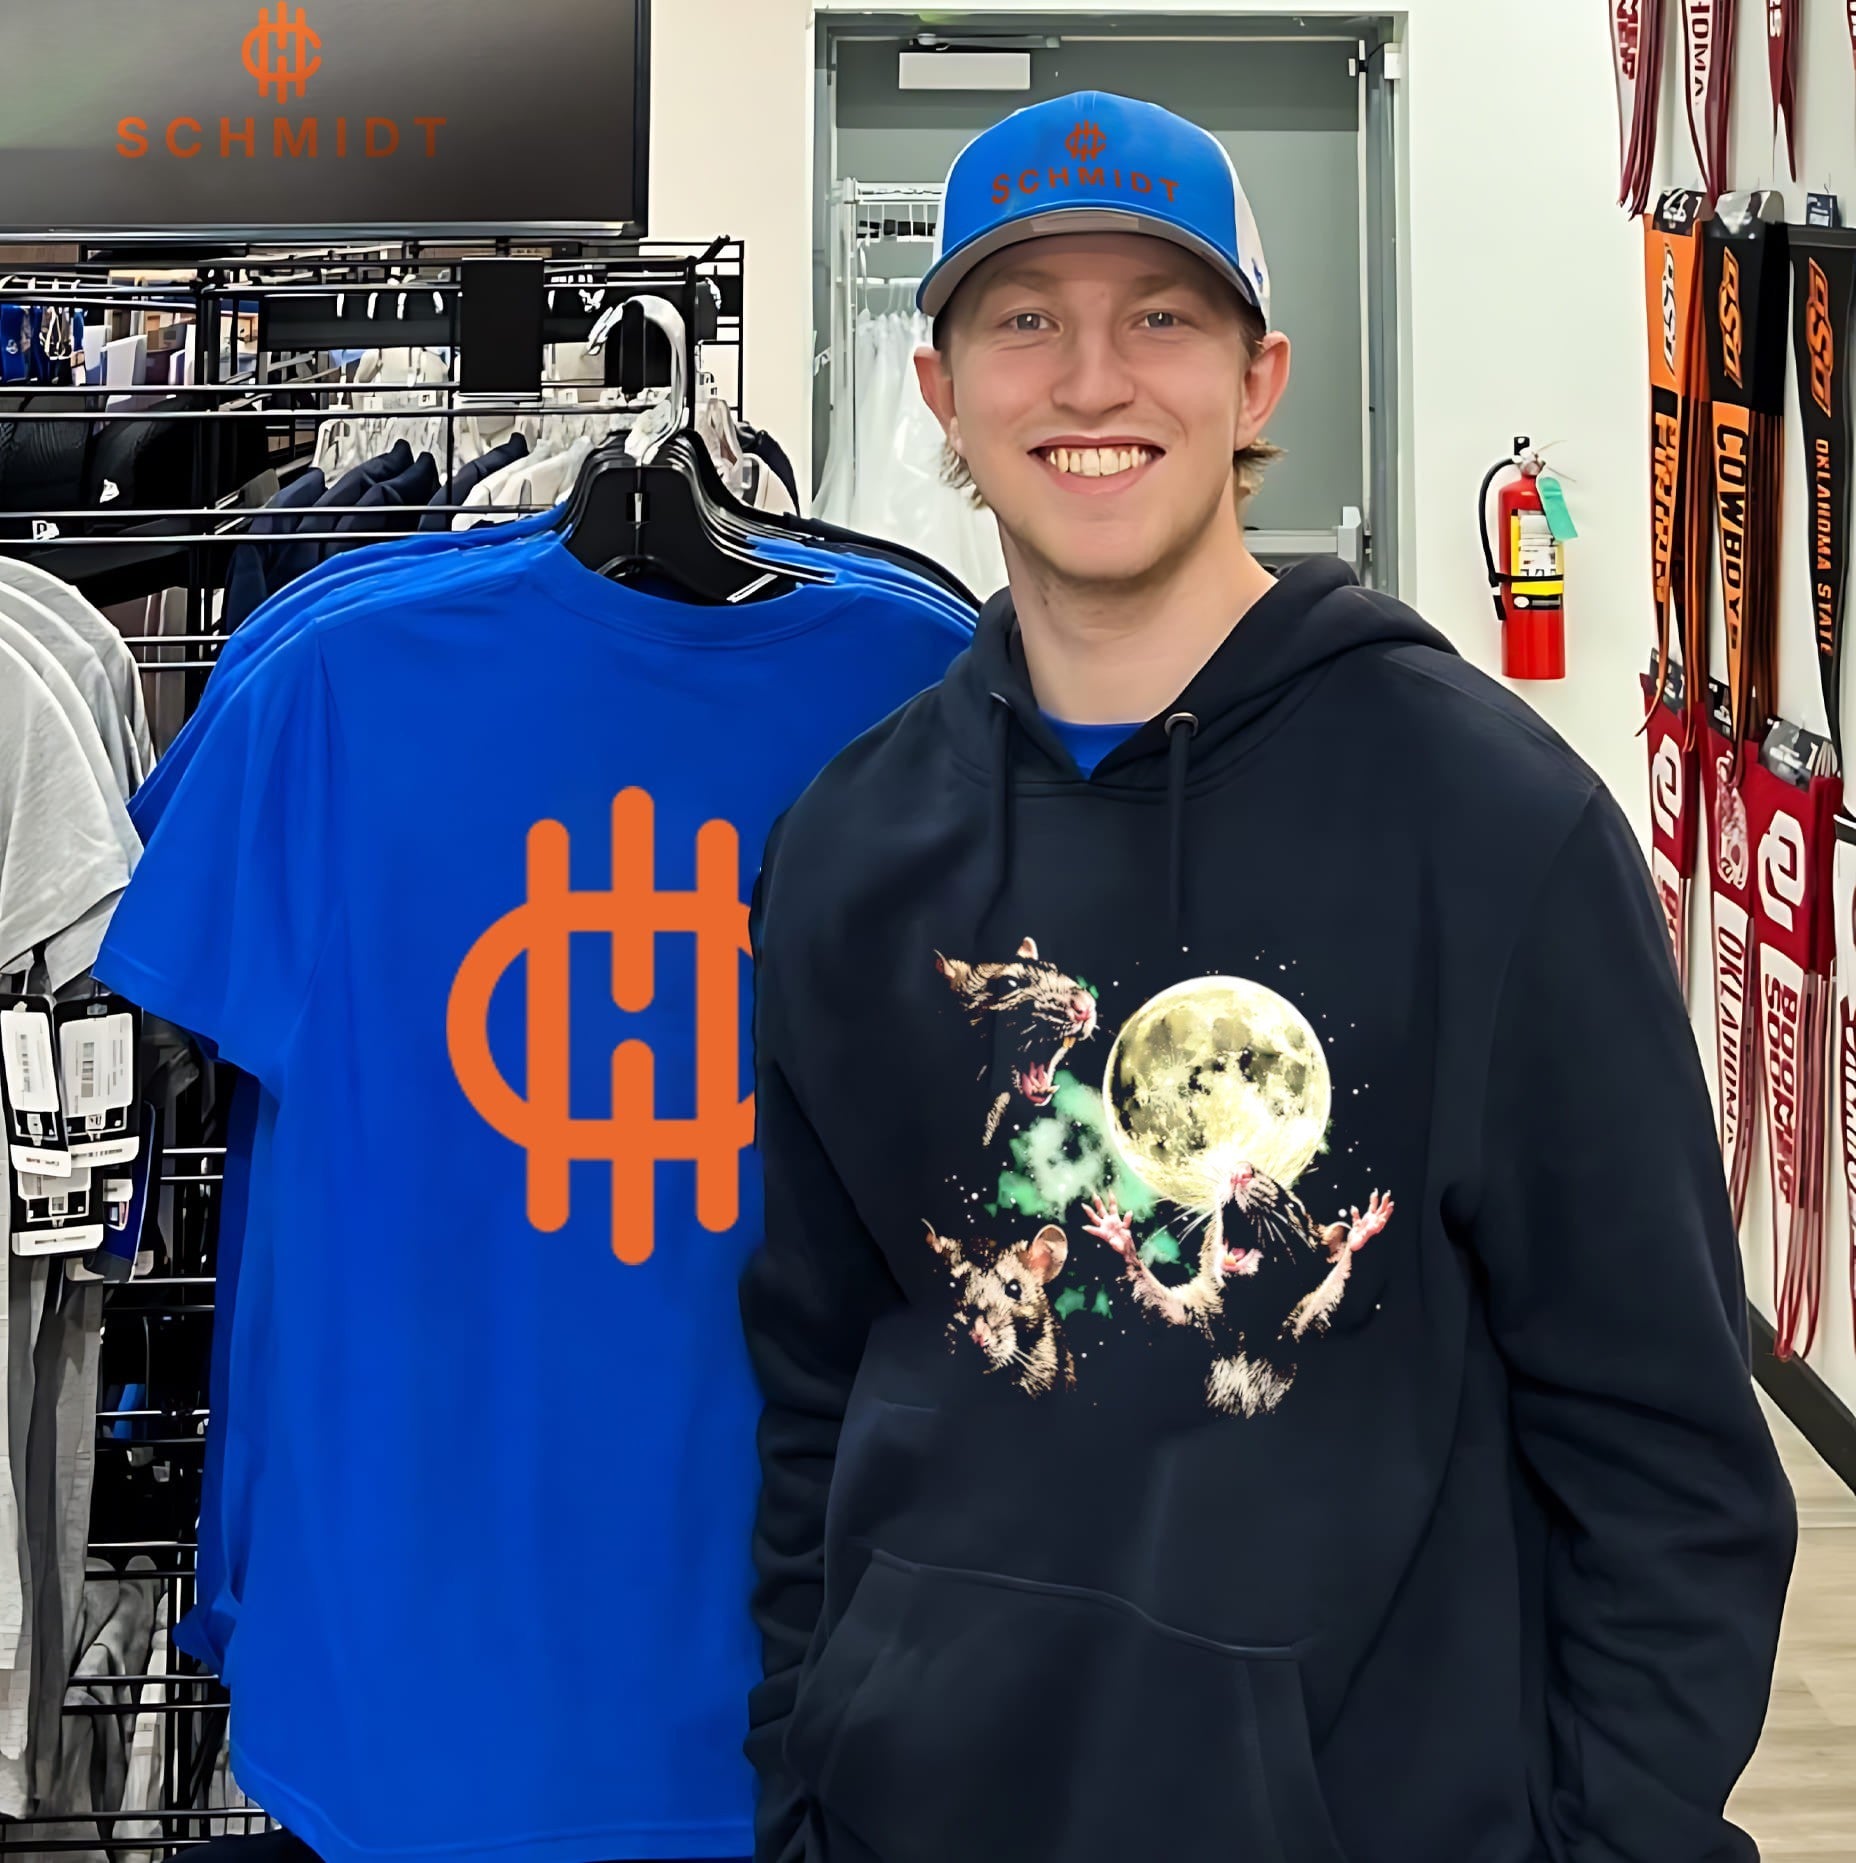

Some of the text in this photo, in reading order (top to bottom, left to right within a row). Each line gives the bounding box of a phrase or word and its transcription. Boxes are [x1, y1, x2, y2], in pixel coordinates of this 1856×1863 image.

[116, 117, 447, 158] SCHMIDT
[991, 166, 1179, 205] SCHMIDT
[1814, 438, 1832, 570] OKLAHOMA
